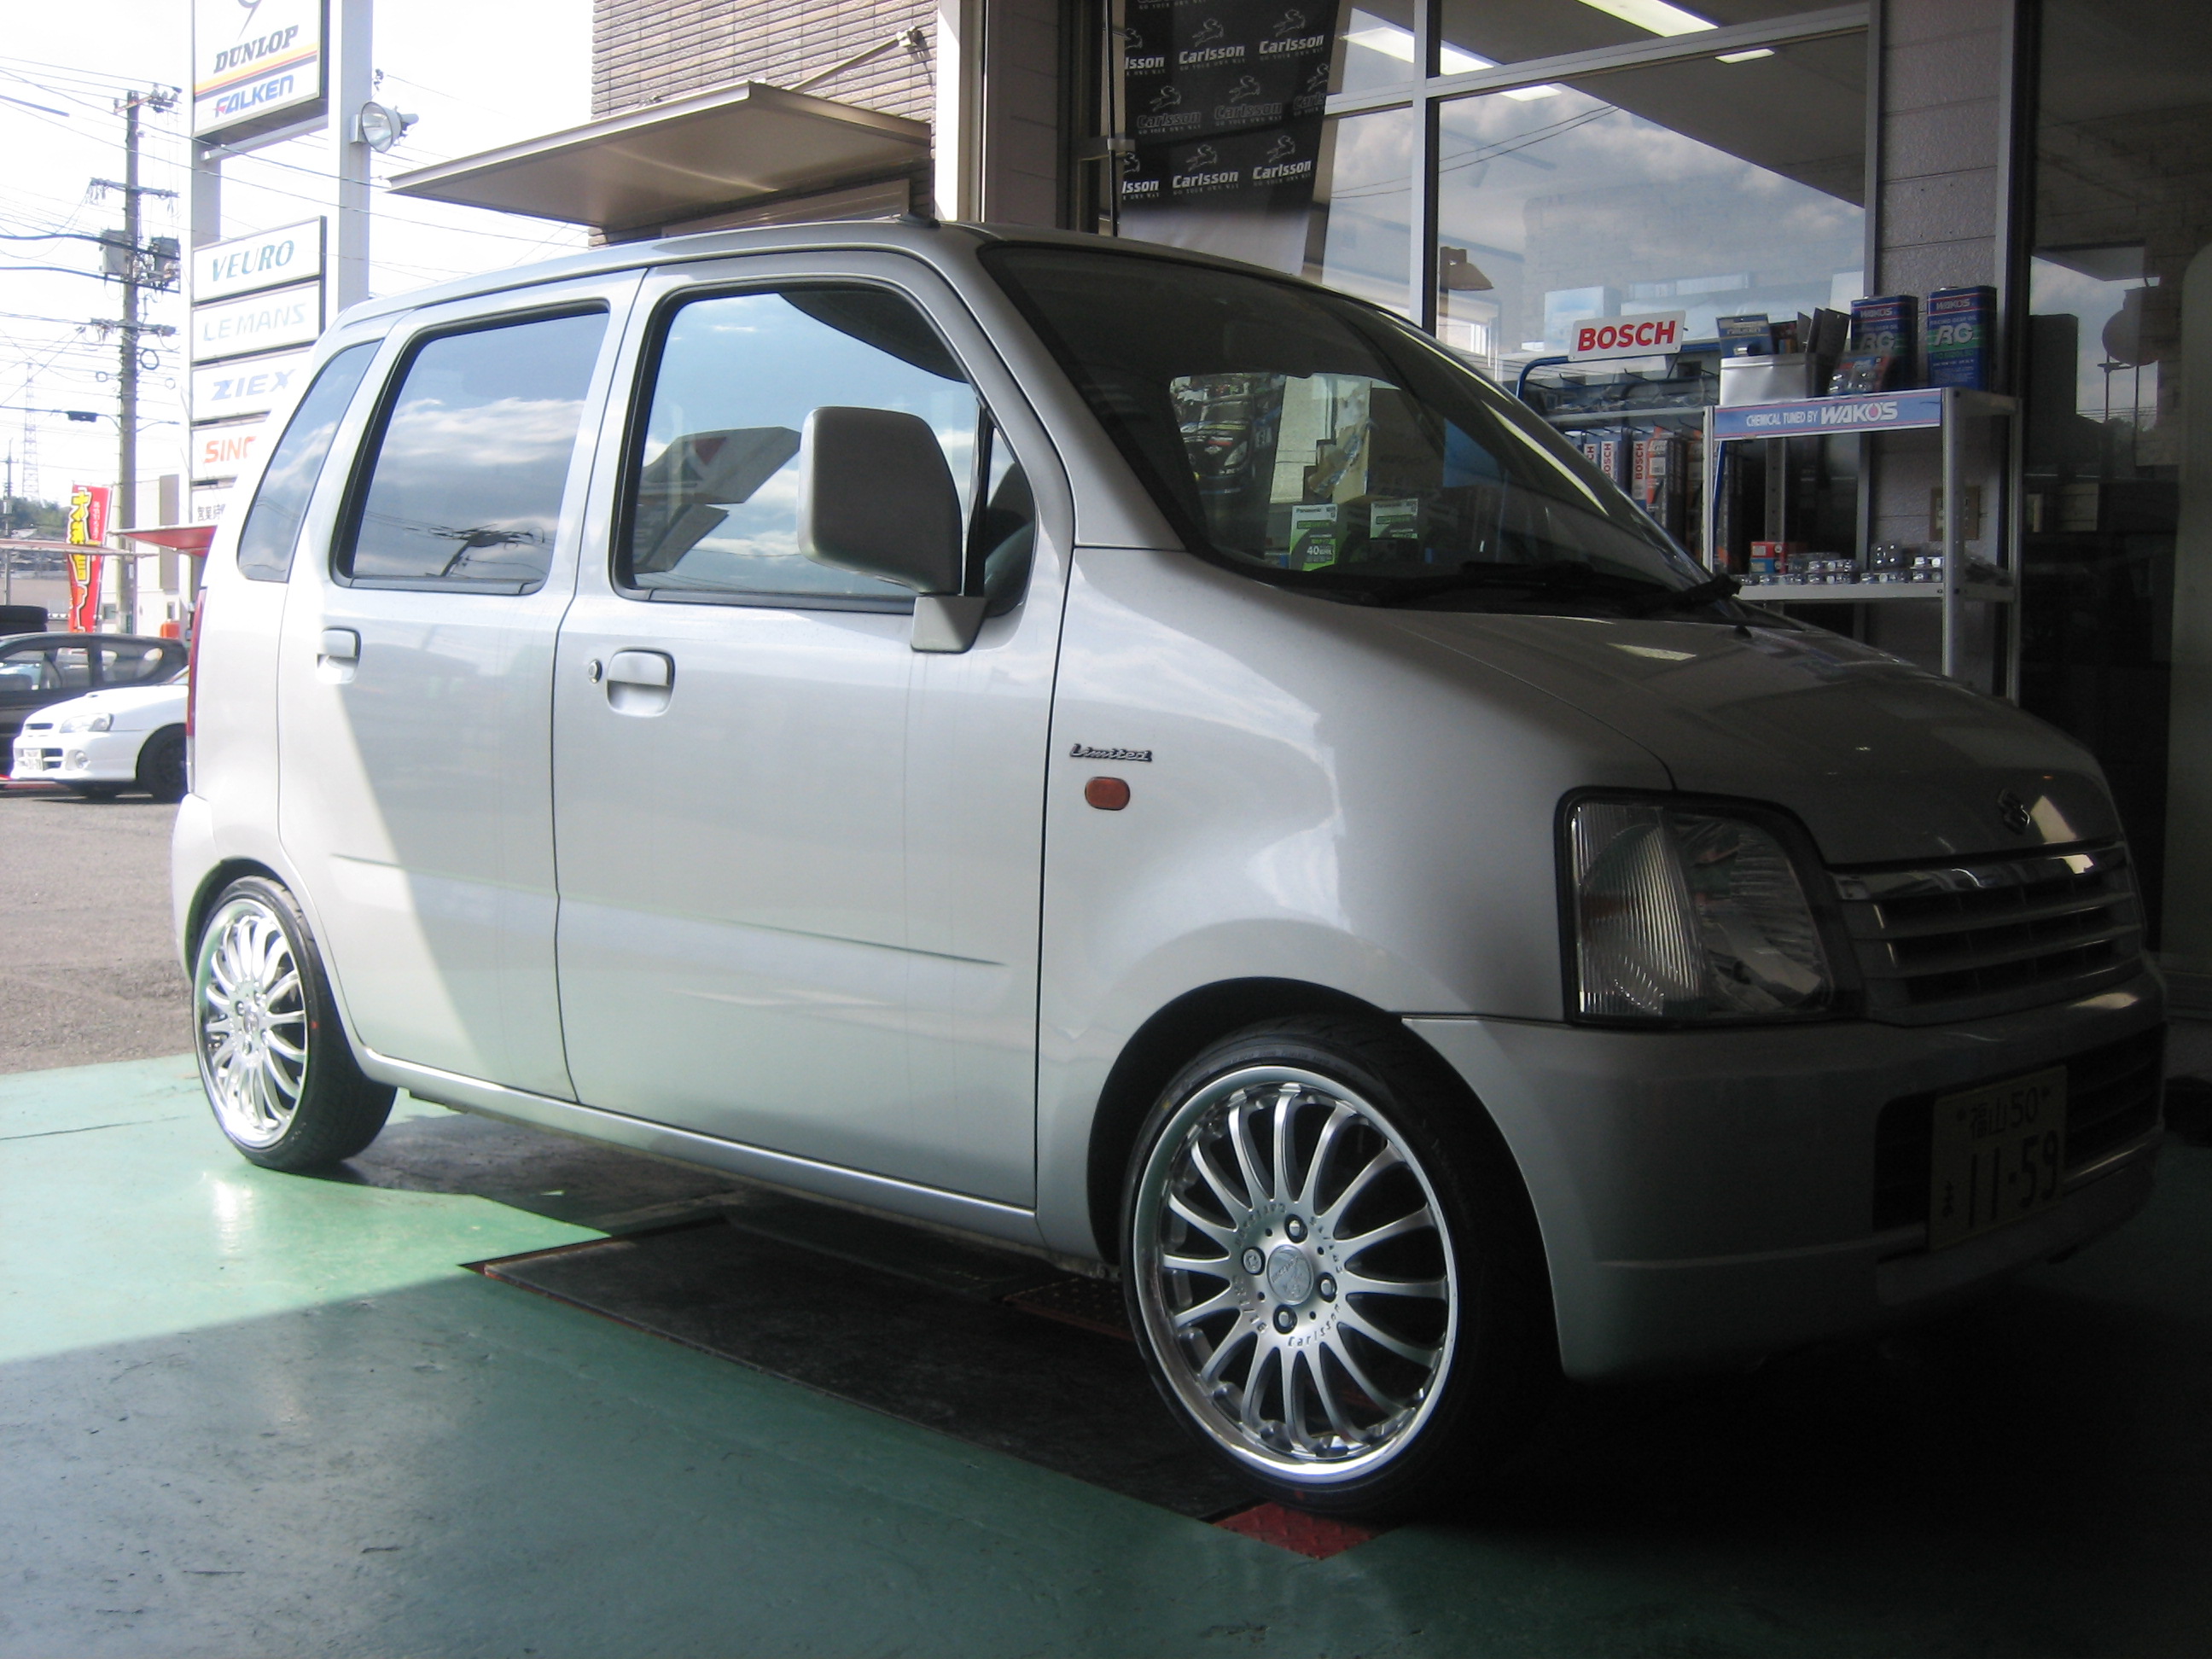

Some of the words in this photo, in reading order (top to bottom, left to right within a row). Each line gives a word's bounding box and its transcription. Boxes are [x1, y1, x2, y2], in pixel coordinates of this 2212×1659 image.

[213, 25, 299, 74] DUNLOP
[1179, 44, 1246, 65] Carlsson
[1259, 34, 1324, 55] Carlsson
[214, 74, 294, 118] FALKEN
[1137, 111, 1202, 129] Carlsson
[1214, 102, 1284, 120] Carlsson
[1173, 170, 1239, 189] Carlsson
[1252, 160, 1313, 180] Carlsson
[212, 239, 295, 282] VEURO
[1577, 319, 1675, 352] BOSCH
[1860, 331, 1895, 352] RG
[1934, 323, 1974, 347] RG
[211, 369, 296, 401] ZIEX
[1746, 411, 1781, 428] CHEMICAL
[1783, 410, 1805, 424] TUNED
[1806, 410, 1819, 423] BY
[1635, 442, 1644, 480] BOSCH
[1069, 742, 1153, 763] Limited
